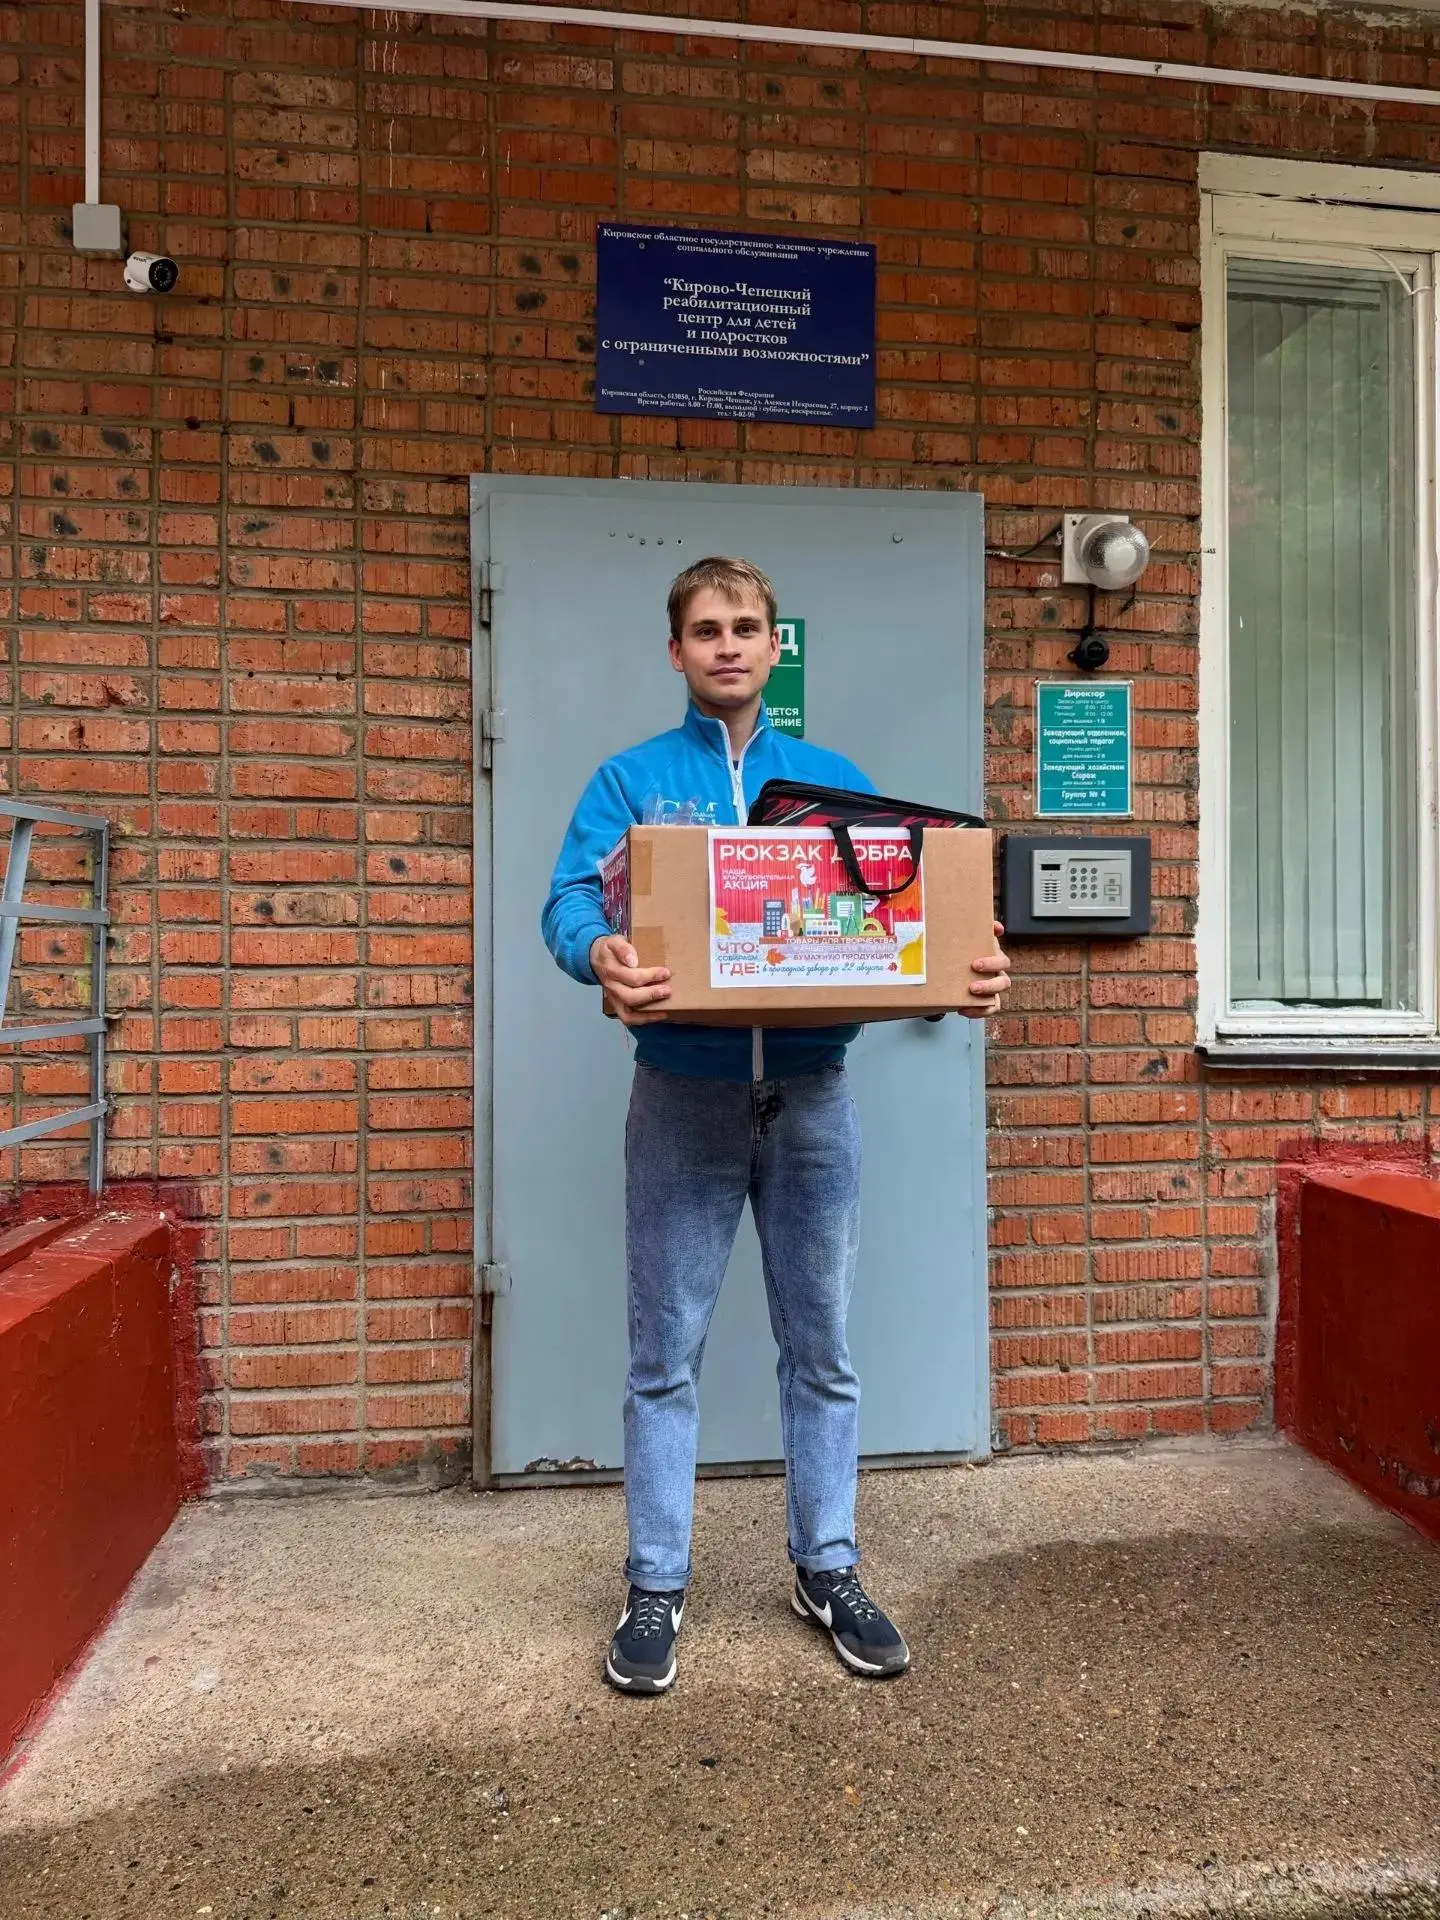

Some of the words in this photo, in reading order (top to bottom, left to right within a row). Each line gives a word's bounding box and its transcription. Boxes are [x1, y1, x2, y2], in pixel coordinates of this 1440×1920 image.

[603, 228, 652, 240] Кировское
[654, 232, 699, 243] областное
[701, 237, 774, 249] государственное
[776, 241, 816, 252] казенное
[817, 245, 870, 257] учреждение
[677, 244, 733, 255] социального
[735, 247, 799, 259] обслуживания
[663, 295, 811, 316] реабилитационный
[678, 313, 722, 328] центр
[726, 317, 751, 328] для
[755, 317, 797, 330] детей
[686, 329, 697, 339] и
[701, 330, 788, 345] подростков
[601, 339, 611, 349] с
[614, 340, 738, 357] ограниченными
[698, 388, 736, 397] Российская
[738, 390, 775, 398] Федерация
[601, 388, 638, 397] Кировская
[764, 399, 791, 407] Алексея
[841, 404, 862, 412] корпус
[637, 398, 659, 407] Время
[725, 404, 758, 413] выходной
[1063, 689, 1105, 699] Директор
[1043, 728, 1085, 738] Заведующий
[1048, 737, 1088, 745] социальный
[1043, 763, 1085, 773] Заведующий
[1087, 763, 1125, 771] хозяйством
[1071, 771, 1097, 780] Сторож
[1061, 790, 1087, 800] Группа
[1100, 790, 1106, 798] 4
[719, 844, 823, 861] РЮКЗАК
[723, 880, 768, 890] АКЦИЯ
[717, 942, 759, 953] ЧТО:
[821, 937, 838, 945] ДЛЯ
[719, 962, 760, 976] ГДЕ:
[769, 965, 804, 976] проходной
[807, 962, 829, 976] завода
[830, 964, 839, 976] до
[842, 961, 855, 971] 22
[856, 962, 884, 975] августа
